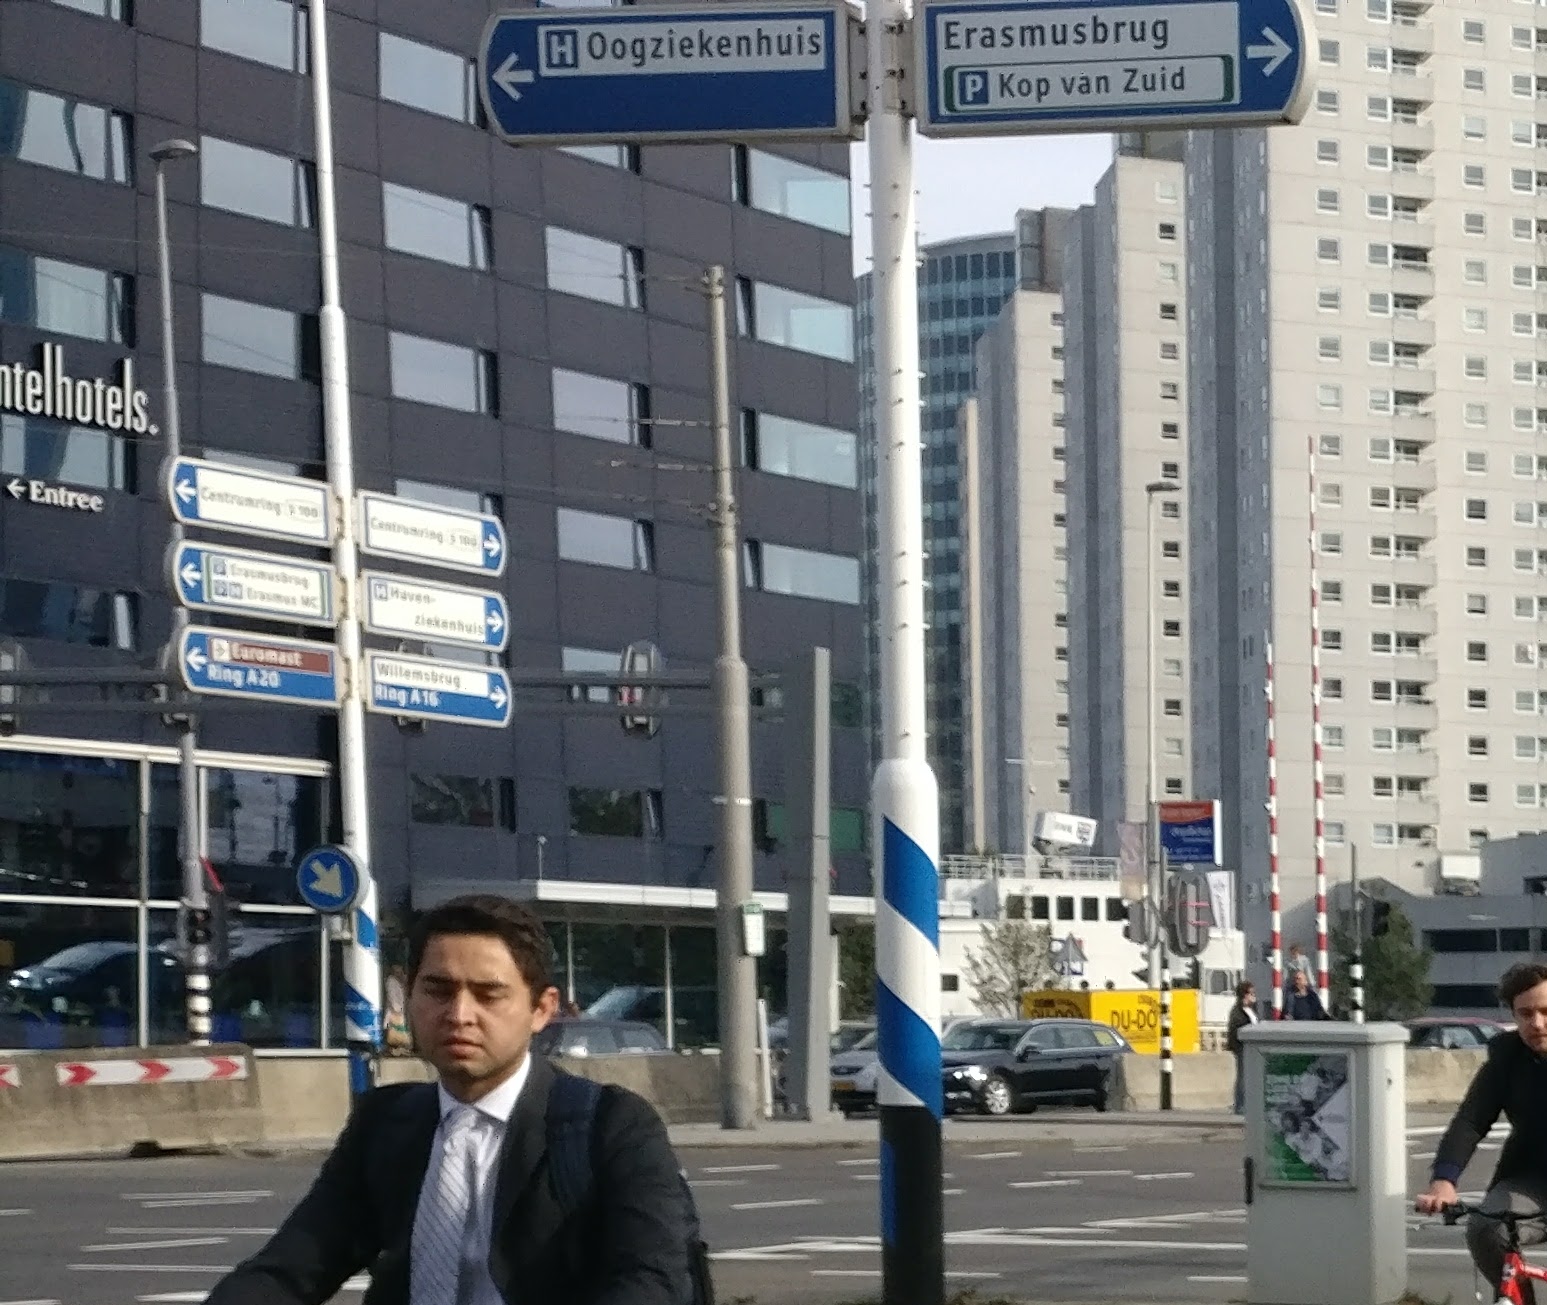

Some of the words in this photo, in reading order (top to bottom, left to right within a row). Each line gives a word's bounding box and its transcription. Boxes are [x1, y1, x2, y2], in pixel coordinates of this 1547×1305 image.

[587, 26, 822, 67] Oogziekenhuis
[943, 15, 1170, 50] Erasmusbrug
[999, 73, 1051, 101] Kop
[1061, 72, 1111, 95] van
[1122, 66, 1187, 94] Zuid
[29, 479, 104, 513] Entree
[201, 486, 281, 517] Centrumring
[370, 516, 444, 544] Centrumring
[390, 588, 437, 605] Haven-
[414, 614, 484, 637] ziekenhuis
[207, 663, 245, 689] Ring
[377, 663, 461, 689] Willemsbrug
[375, 683, 406, 707] Ring
